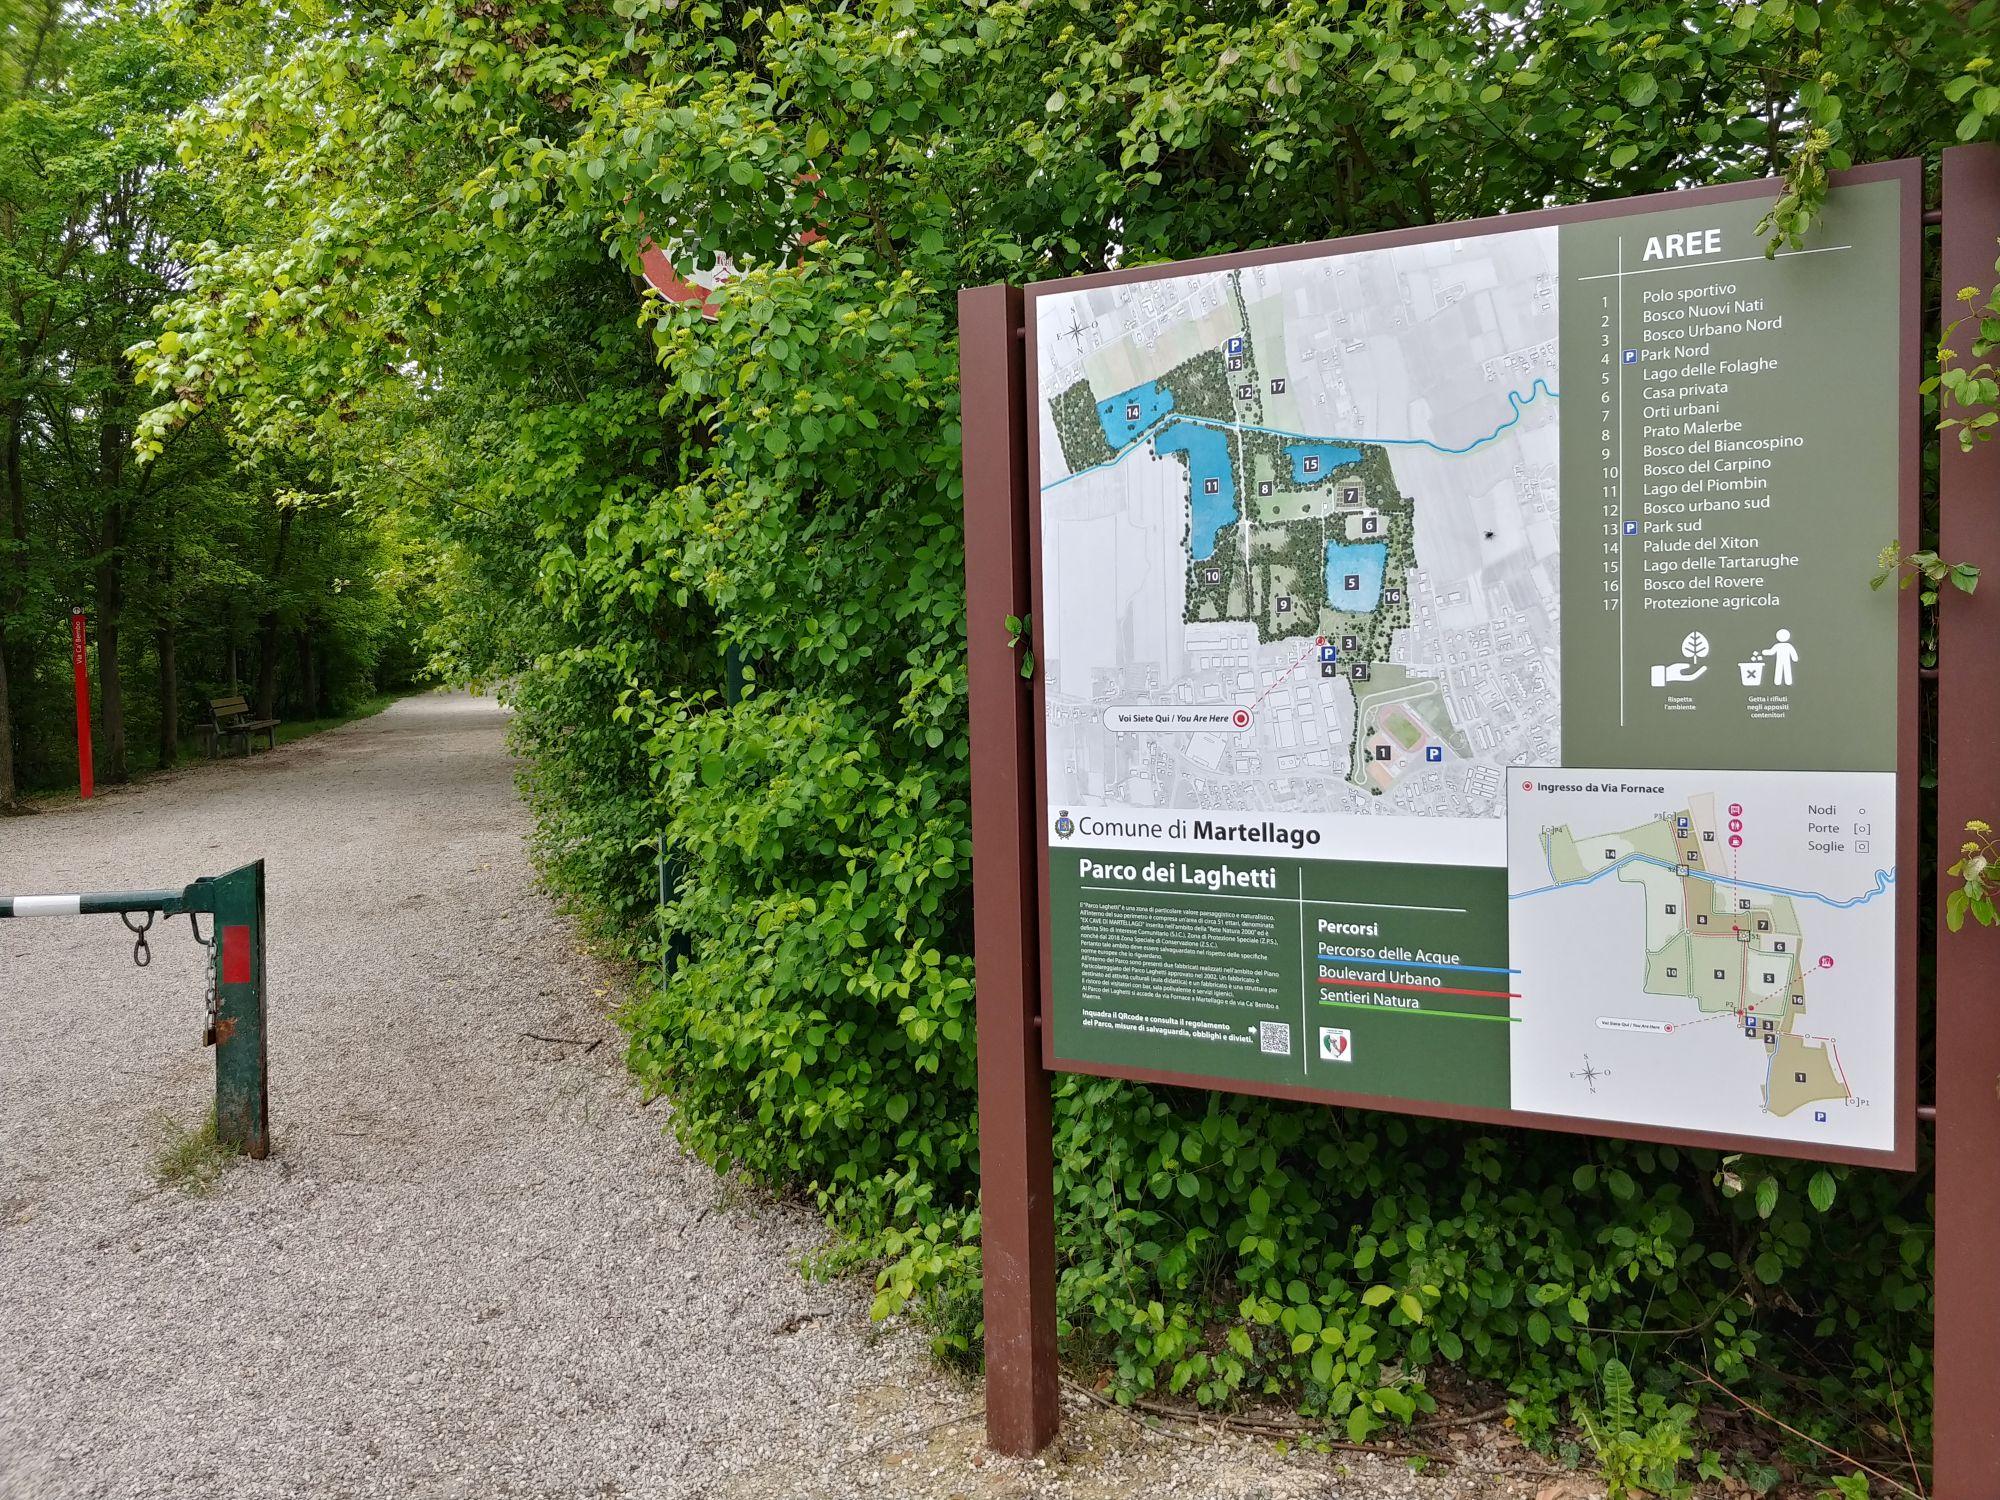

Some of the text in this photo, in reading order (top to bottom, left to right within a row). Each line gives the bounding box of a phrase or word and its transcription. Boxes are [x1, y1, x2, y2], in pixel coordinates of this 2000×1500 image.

[1642, 229, 1721, 261] AREE
[1603, 283, 1736, 308] 1 Polo sportivo
[1601, 298, 1763, 327] 2 Bosco Nuovi Nati
[1602, 316, 1782, 346] 3 Bosco Urbano Nord
[1231, 340, 1240, 352] P
[1601, 343, 1709, 365] 4 P Park Nord
[1229, 359, 1241, 369] 13
[1602, 357, 1777, 384] 5 Lago delle Folaghe
[1239, 387, 1252, 398] 12
[1272, 381, 1284, 392] 17
[1601, 383, 1728, 403] 6 Casa privata
[1127, 407, 1139, 418] 14
[1602, 401, 1719, 422] 7 Orti urbani
[1602, 419, 1742, 441] 8 Prato Malerbe
[1602, 435, 1803, 460] 9 Bosco del Biancospino
[1304, 459, 1318, 470] 15
[1603, 457, 1771, 478] 10 Bosco del Carpino
[1206, 481, 1217, 492] 11
[1261, 484, 1269, 494] 8
[1603, 476, 1767, 498] 11 Lago del Piombin
[1347, 491, 1355, 501] 7
[1603, 495, 1770, 516] 12 Bosco urbano sud
[1365, 520, 1374, 531] 6
[1603, 518, 1702, 535] 13 P Park sud
[1603, 537, 1758, 554] 14 Palude del Xiton
[1603, 553, 1799, 574] 15 Lago delle Tartarughe
[1207, 571, 1218, 581] 10
[1348, 578, 1356, 588] 5
[1603, 576, 1764, 592] 16 Bosco del Rovere
[1385, 591, 1399, 602] 16
[1603, 593, 1779, 610] 17 Protezione agricola
[1280, 600, 1288, 610] 9
[1345, 638, 1353, 649] 3
[1324, 648, 1334, 660] P
[1325, 665, 1333, 675] 4
[1355, 667, 1363, 677] 2
[1133, 714, 1154, 722] Siete
[1155, 714, 1170, 723] Qui
[1177, 714, 1192, 722] You
[1193, 714, 1208, 722] Are
[1380, 748, 1386, 758] 1
[1429, 748, 1439, 760] P
[1538, 782, 1664, 794] Ingresso da Via Fornace
[1808, 805, 1836, 815] Nodi
[1079, 817, 1320, 849] Comune di Martellago
[1809, 823, 1840, 833] Porte
[1808, 841, 1844, 853] Soglie
[1080, 859, 1276, 891] Parco dei Laghetti
[1318, 919, 1378, 936] Percorsi
[1319, 942, 1460, 965] Percorso delle Acque
[1319, 965, 1441, 987] Boulevard Urbano
[1320, 988, 1419, 1008] Sentieri Natura
[1082, 1008, 1112, 1018] Inquadra
[1112, 1011, 1117, 1019] il
[1150, 1017, 1179, 1025] consulta
[1179, 1018, 1184, 1026] il
[1185, 1020, 1230, 1030] regolamento
[1082, 1018, 1093, 1026] del
[1094, 1019, 1114, 1029] Parco,
[1114, 1022, 1137, 1031] misure
[1146, 1025, 1191, 1037] salvaguardia,
[1192, 1030, 1222, 1041] obblighi
[1228, 1034, 1253, 1043] divieti.
